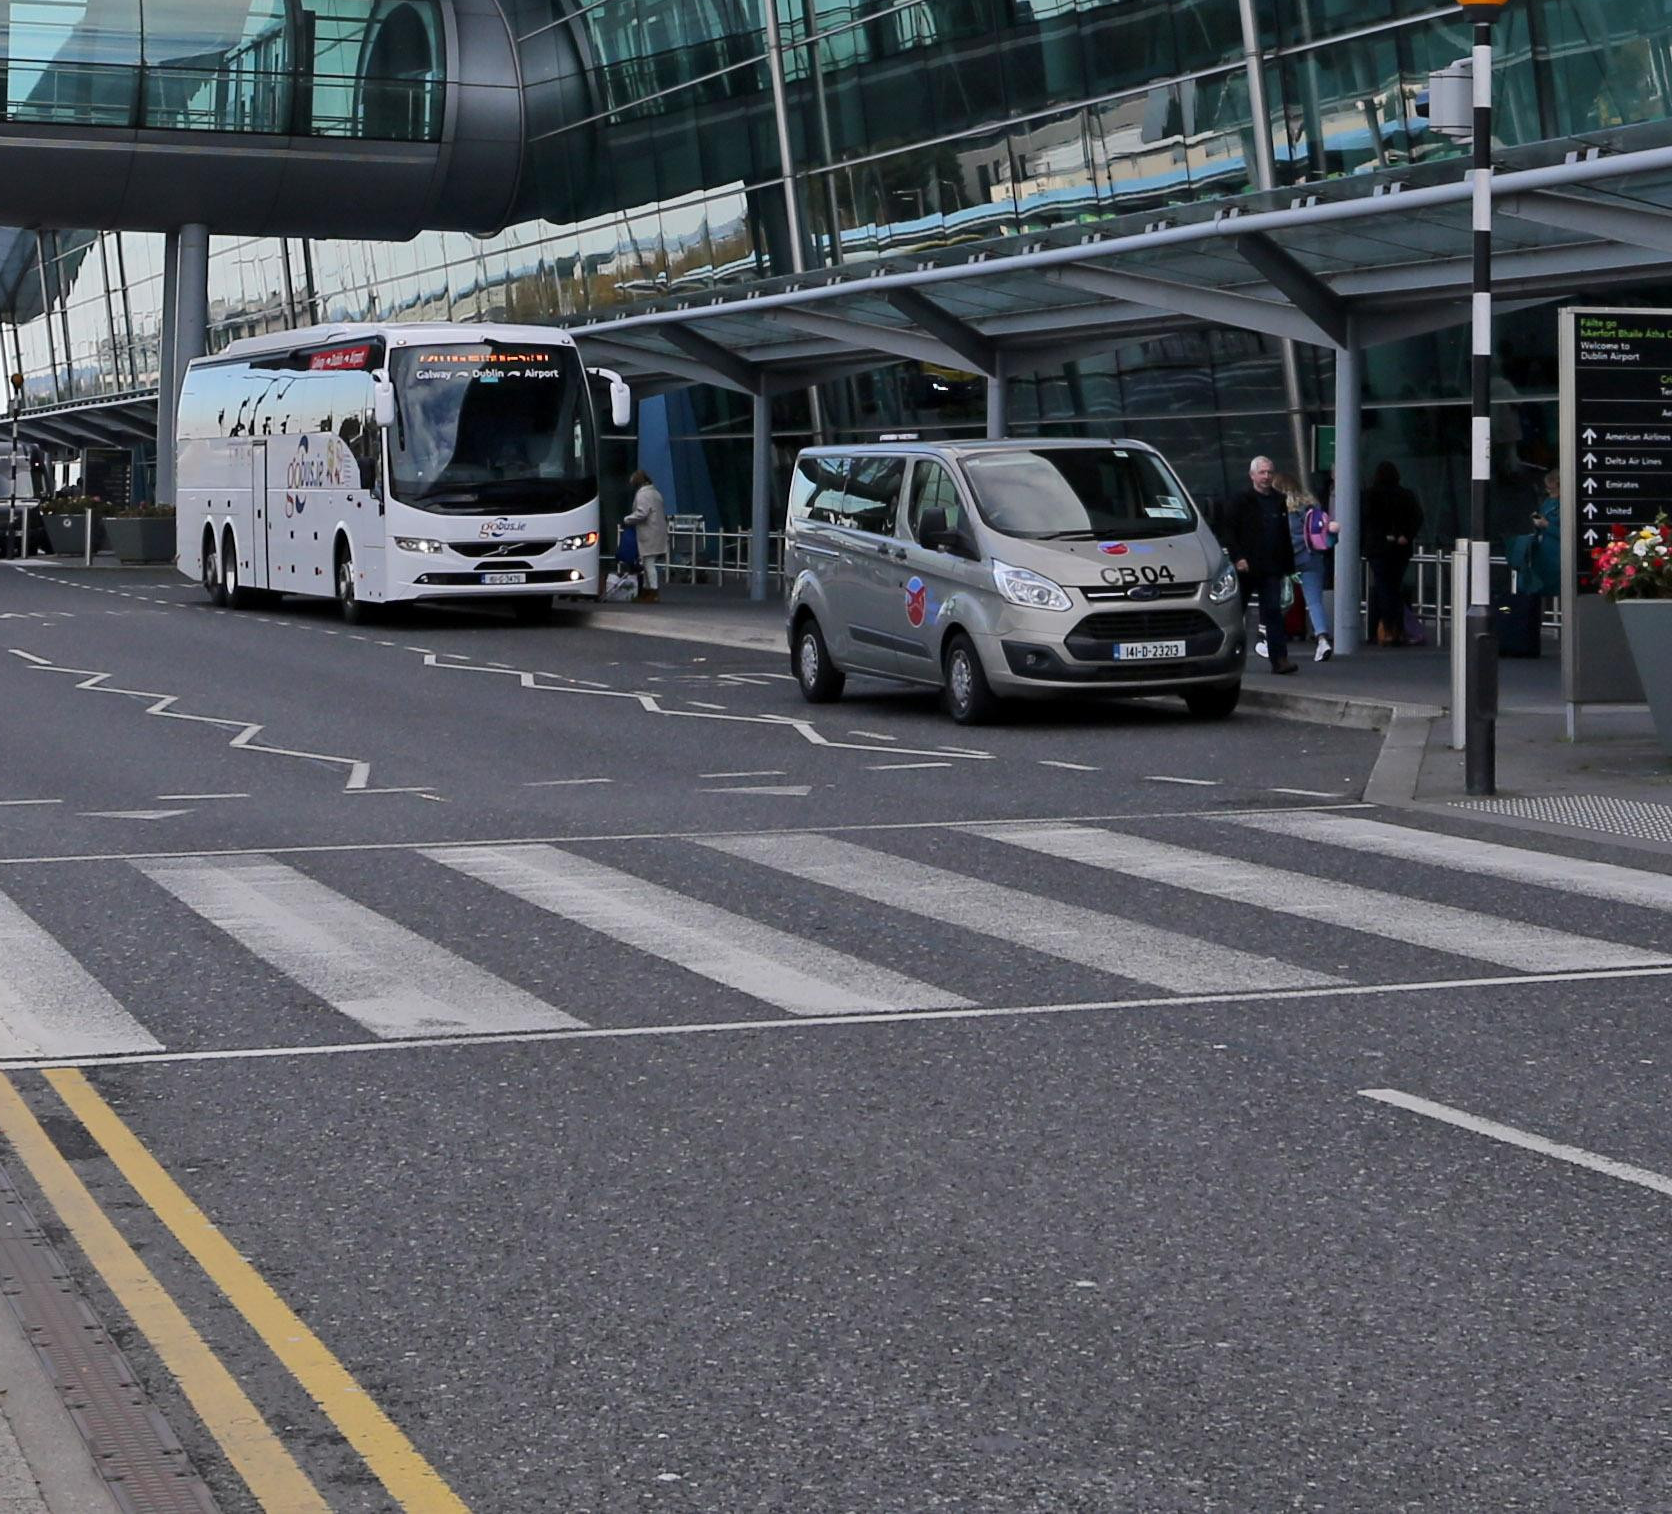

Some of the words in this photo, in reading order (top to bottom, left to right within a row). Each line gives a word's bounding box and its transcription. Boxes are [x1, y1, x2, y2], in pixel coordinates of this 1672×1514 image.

[1605, 320, 1617, 329] go
[1580, 341, 1619, 350] Welcome
[1621, 342, 1630, 350] to
[1580, 351, 1608, 360] Dublin
[1610, 352, 1640, 362] Airport
[416, 369, 453, 380] Galway
[472, 369, 505, 379] Dublin
[524, 369, 559, 379] Airport
[1604, 432, 1641, 441] American
[1643, 432, 1671, 441] Airlines
[1604, 457, 1626, 465] Delta
[1628, 457, 1639, 465] Air
[1642, 457, 1662, 465] Lines
[1605, 480, 1639, 489] Emirates
[1606, 506, 1632, 515] United
